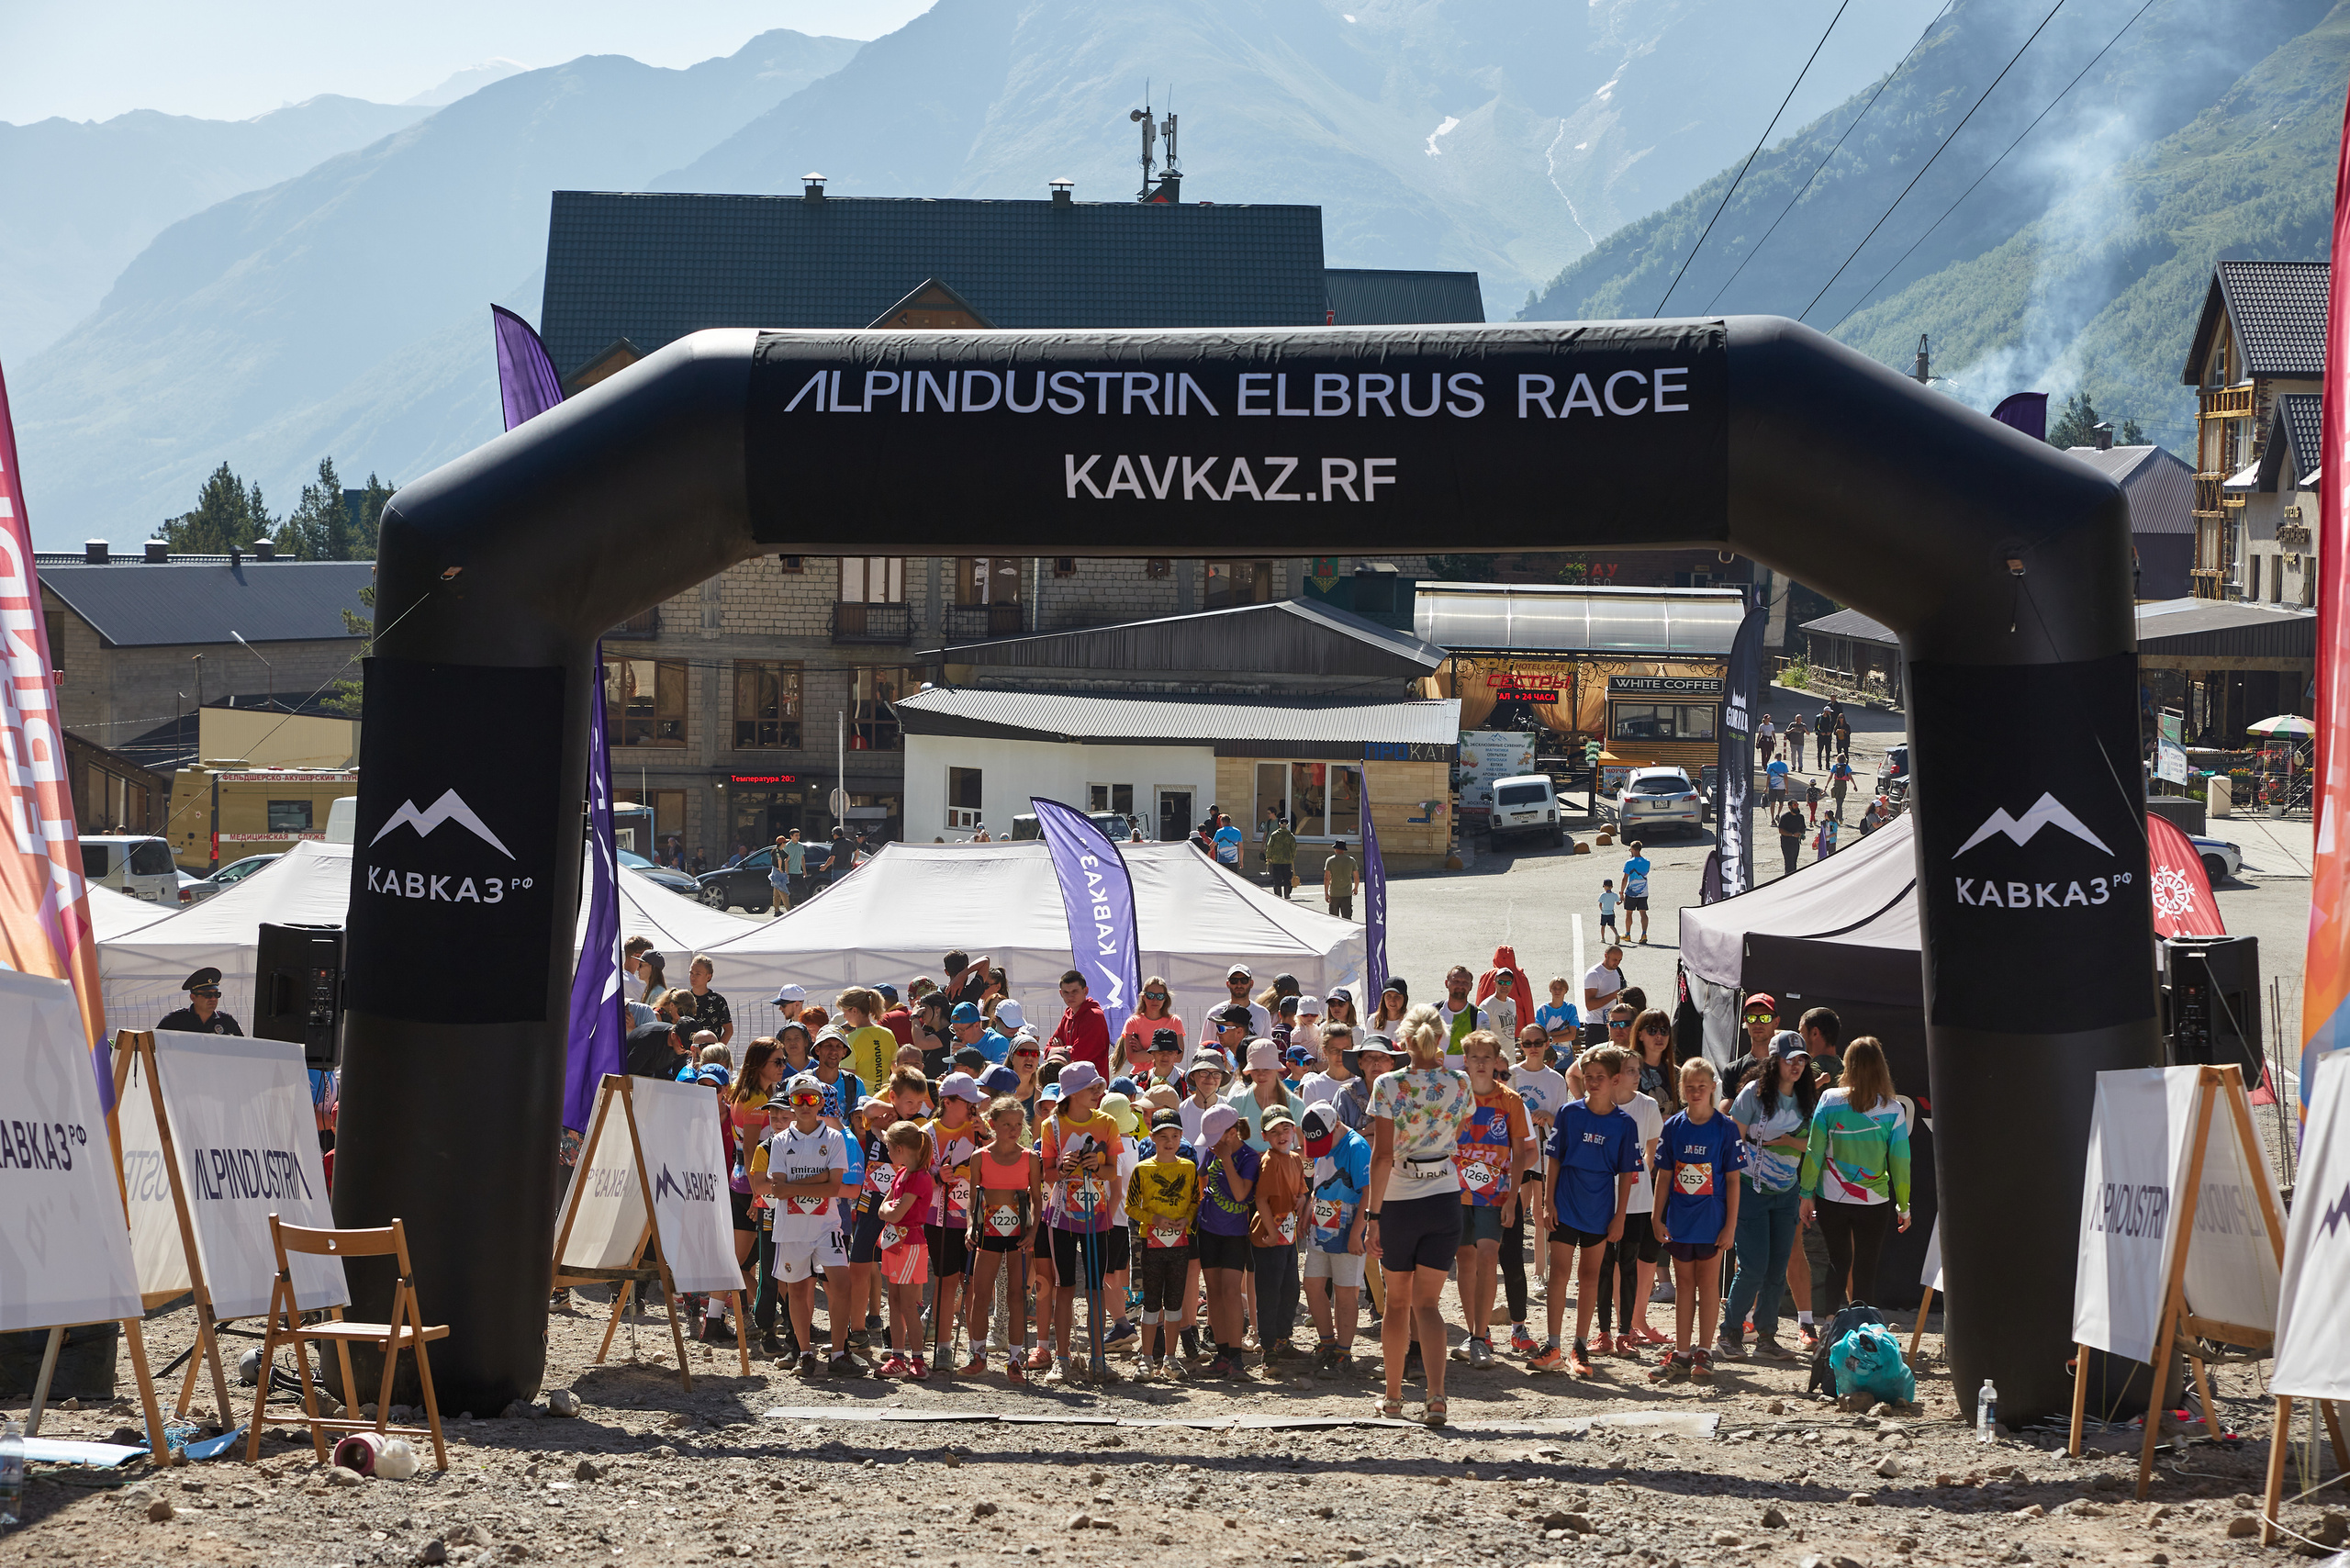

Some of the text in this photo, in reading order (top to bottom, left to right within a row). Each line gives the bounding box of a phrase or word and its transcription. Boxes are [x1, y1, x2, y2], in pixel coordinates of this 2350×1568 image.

[783, 366, 1690, 419] ALPINDUSTRIA ELBRUS RACE
[1064, 454, 1397, 503] KAVKAZ.RF
[1486, 674, 1572, 689] СЕСТРЫ
[1616, 678, 1718, 690] WHITE COFFEE
[1533, 693, 1556, 701] ЧАСА
[1364, 741, 1450, 761] ПРОКАТ
[731, 775, 779, 784] Температура
[229, 833, 289, 842] МЕДИЦИНСКАЯ
[366, 864, 505, 903] КАВКАЗ
[1954, 876, 2111, 909] КАВКАЗ
[1080, 854, 1117, 956] КАВКАЗ
[790, 1165, 824, 1175] Emirate
[1427, 1169, 1448, 1178] RUN
[1463, 1168, 1490, 1183] 1268
[1679, 1173, 1704, 1184] 1253
[796, 1194, 822, 1204] 1249
[951, 1190, 969, 1200] 126
[992, 1215, 1019, 1226] 1220
[1281, 1223, 1294, 1234] 124
[830, 1231, 845, 1249] 11
[882, 1232, 898, 1243] 247
